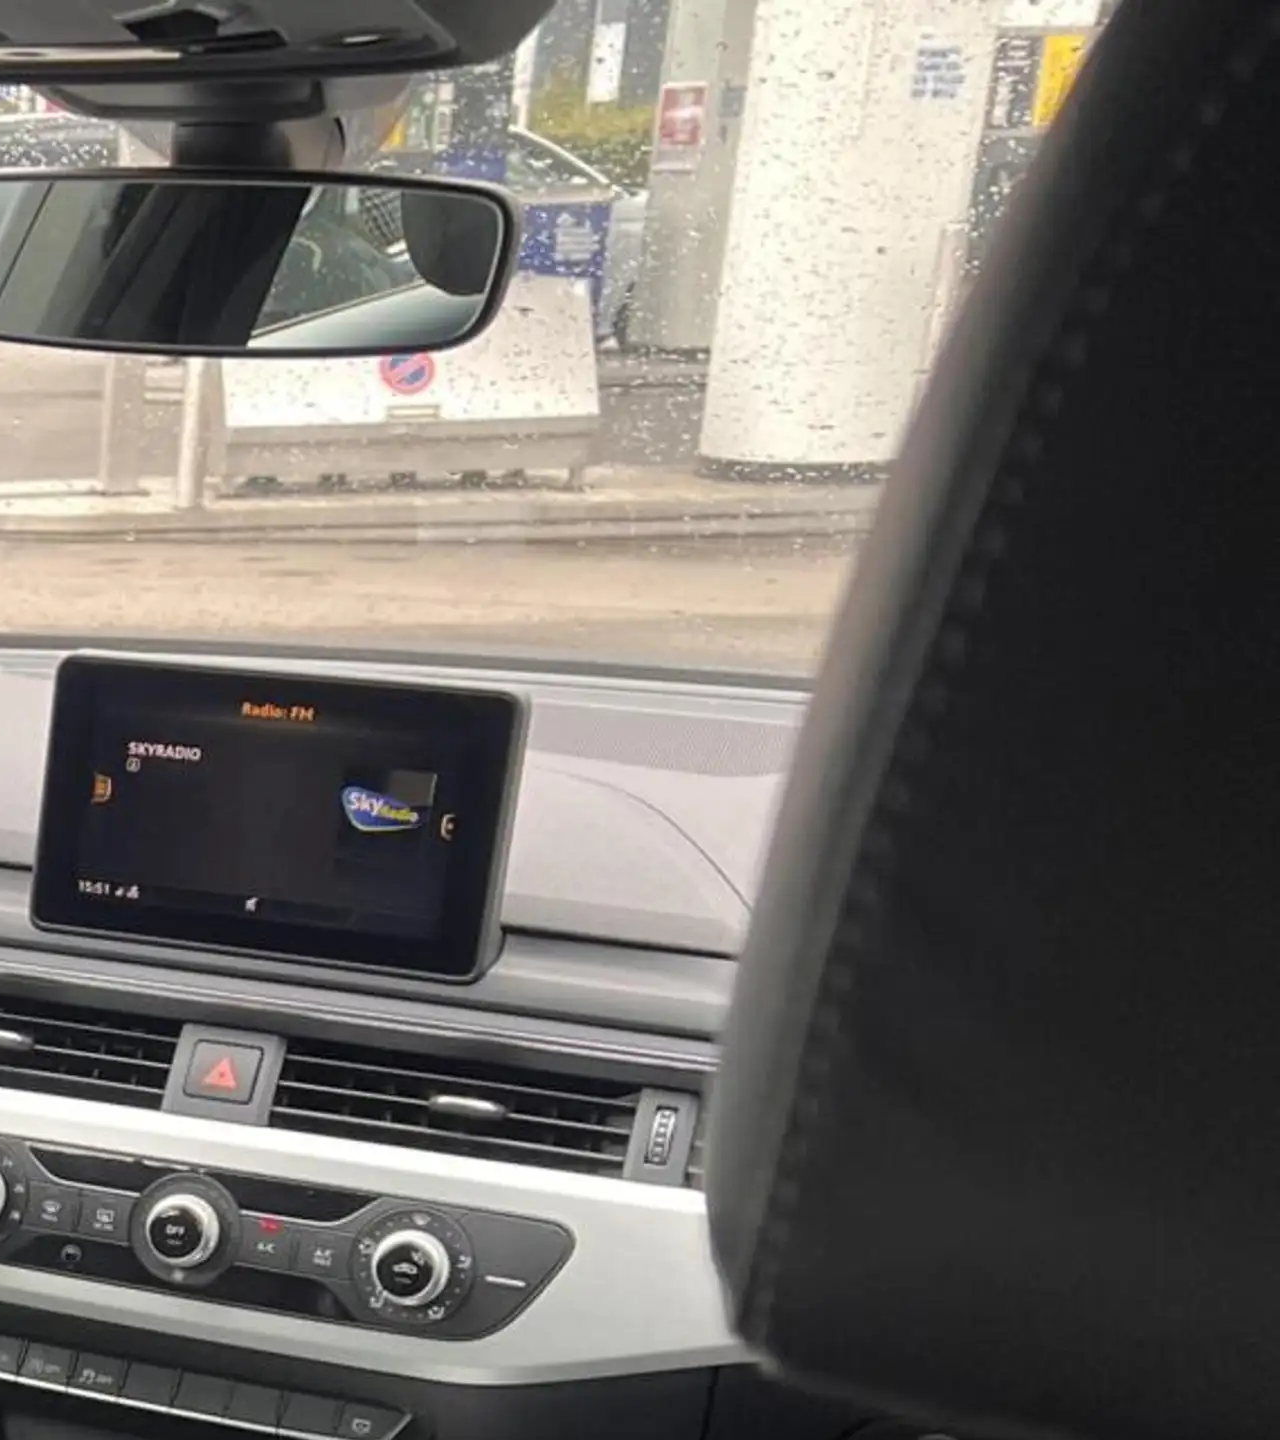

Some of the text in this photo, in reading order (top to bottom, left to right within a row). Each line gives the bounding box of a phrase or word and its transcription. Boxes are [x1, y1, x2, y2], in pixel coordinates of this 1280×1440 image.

[242, 702, 315, 721] Radio: FM
[128, 742, 202, 761] SKYRADIO
[349, 791, 384, 817] Sky
[165, 1223, 185, 1236] OFF
